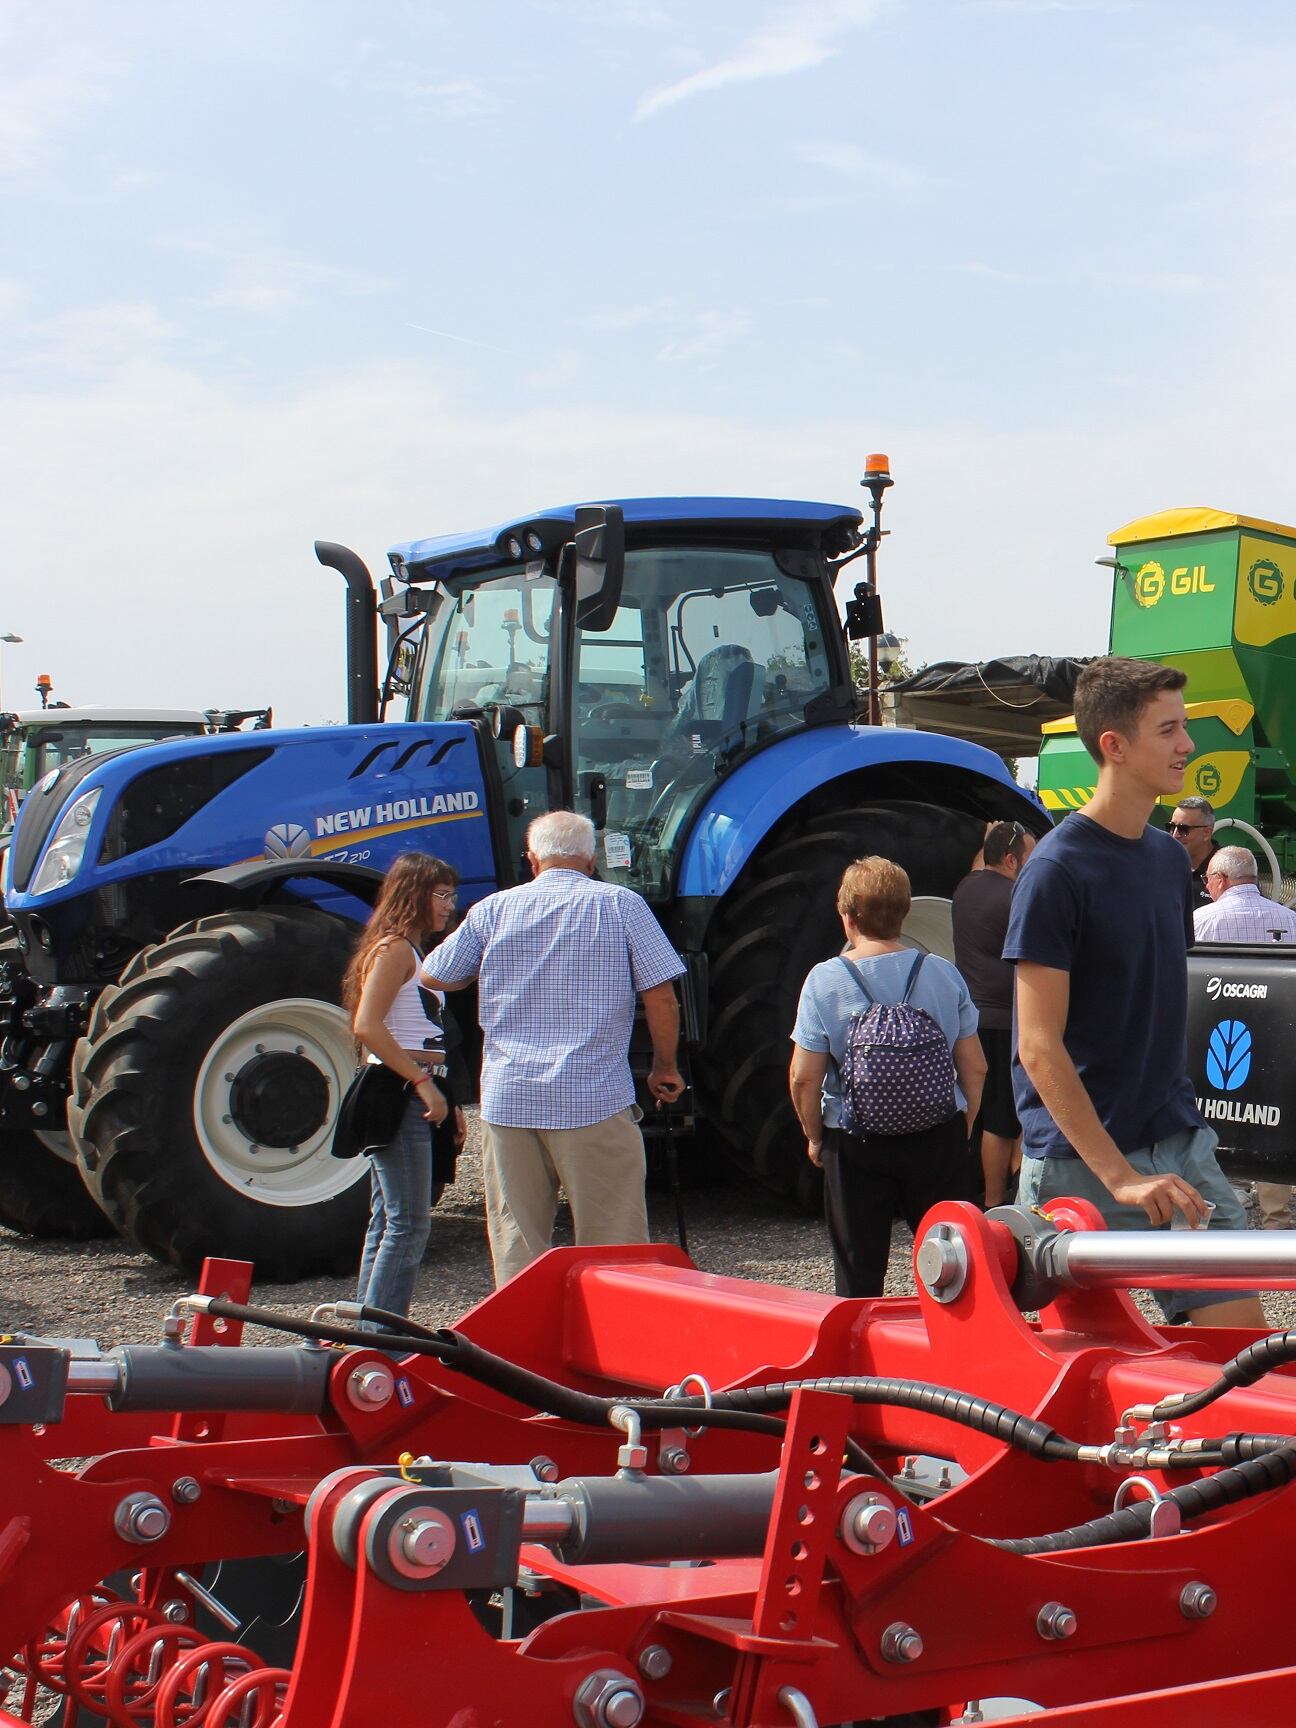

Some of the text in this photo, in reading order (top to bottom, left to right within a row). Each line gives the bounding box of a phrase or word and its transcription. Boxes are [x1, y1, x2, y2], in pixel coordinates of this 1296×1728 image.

[1171, 565, 1215, 595] GIL
[316, 791, 479, 836] NEW HOLLAND
[350, 849, 371, 864] 210
[1222, 982, 1268, 999] OSCAGRI
[1204, 1099, 1281, 1127] HOLLAND
